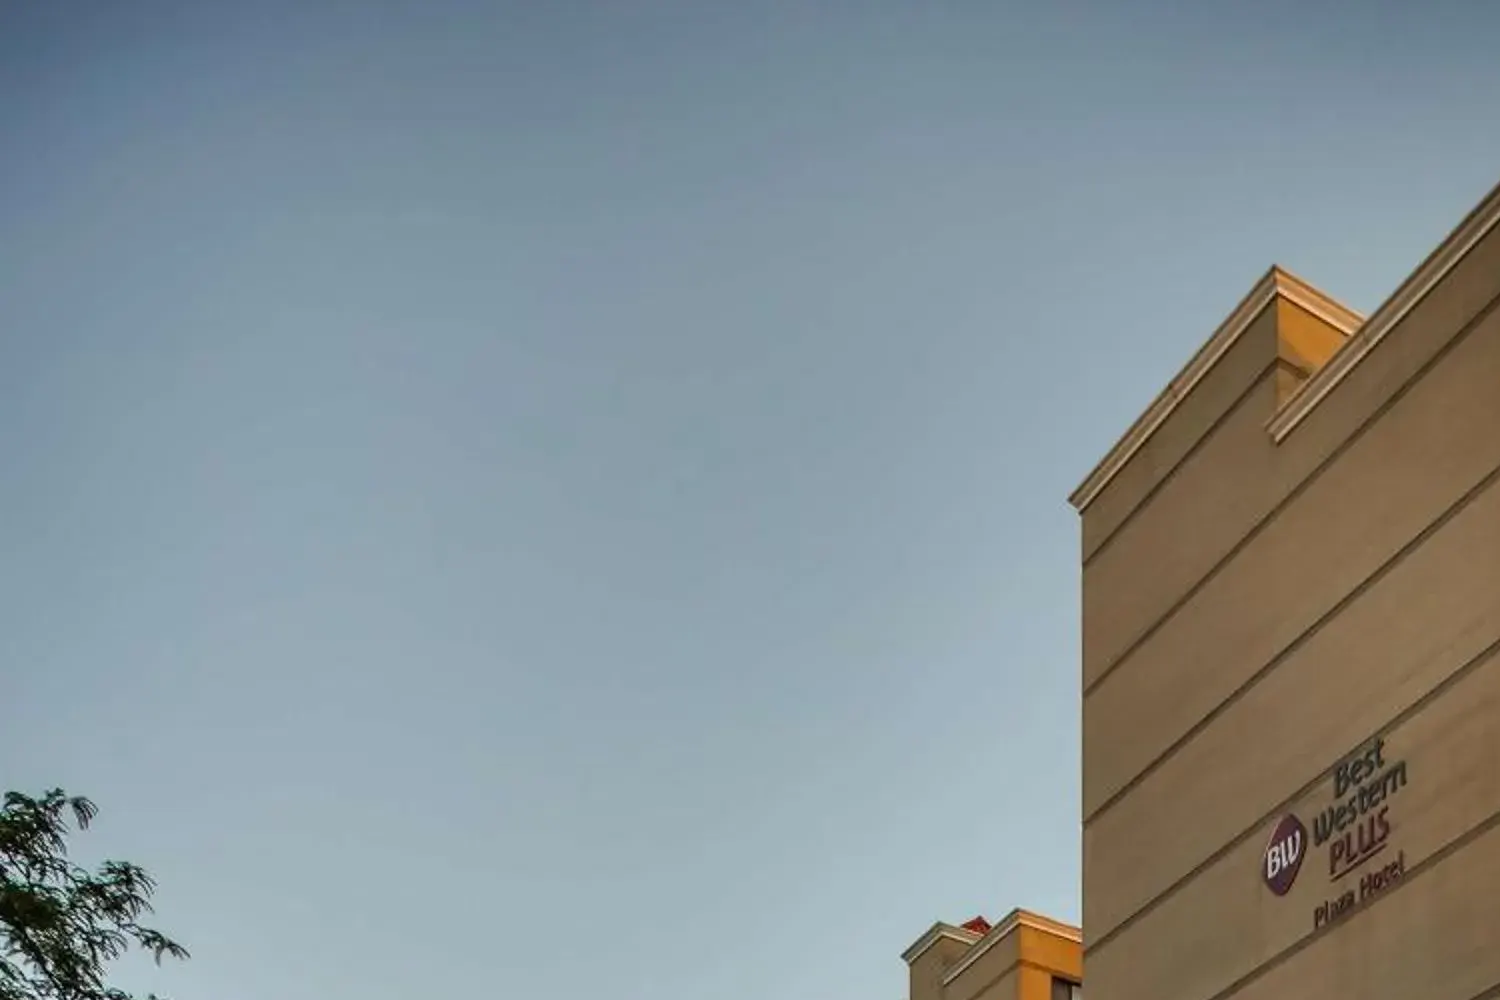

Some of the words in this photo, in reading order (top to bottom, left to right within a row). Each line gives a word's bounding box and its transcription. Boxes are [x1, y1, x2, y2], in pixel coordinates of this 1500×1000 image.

[1312, 760, 1407, 847] Western
[1333, 737, 1385, 799] Best
[1267, 830, 1301, 880] BW
[1329, 805, 1391, 876] PLUS
[1313, 888, 1356, 929] Plaza
[1360, 850, 1405, 900] Hotel
